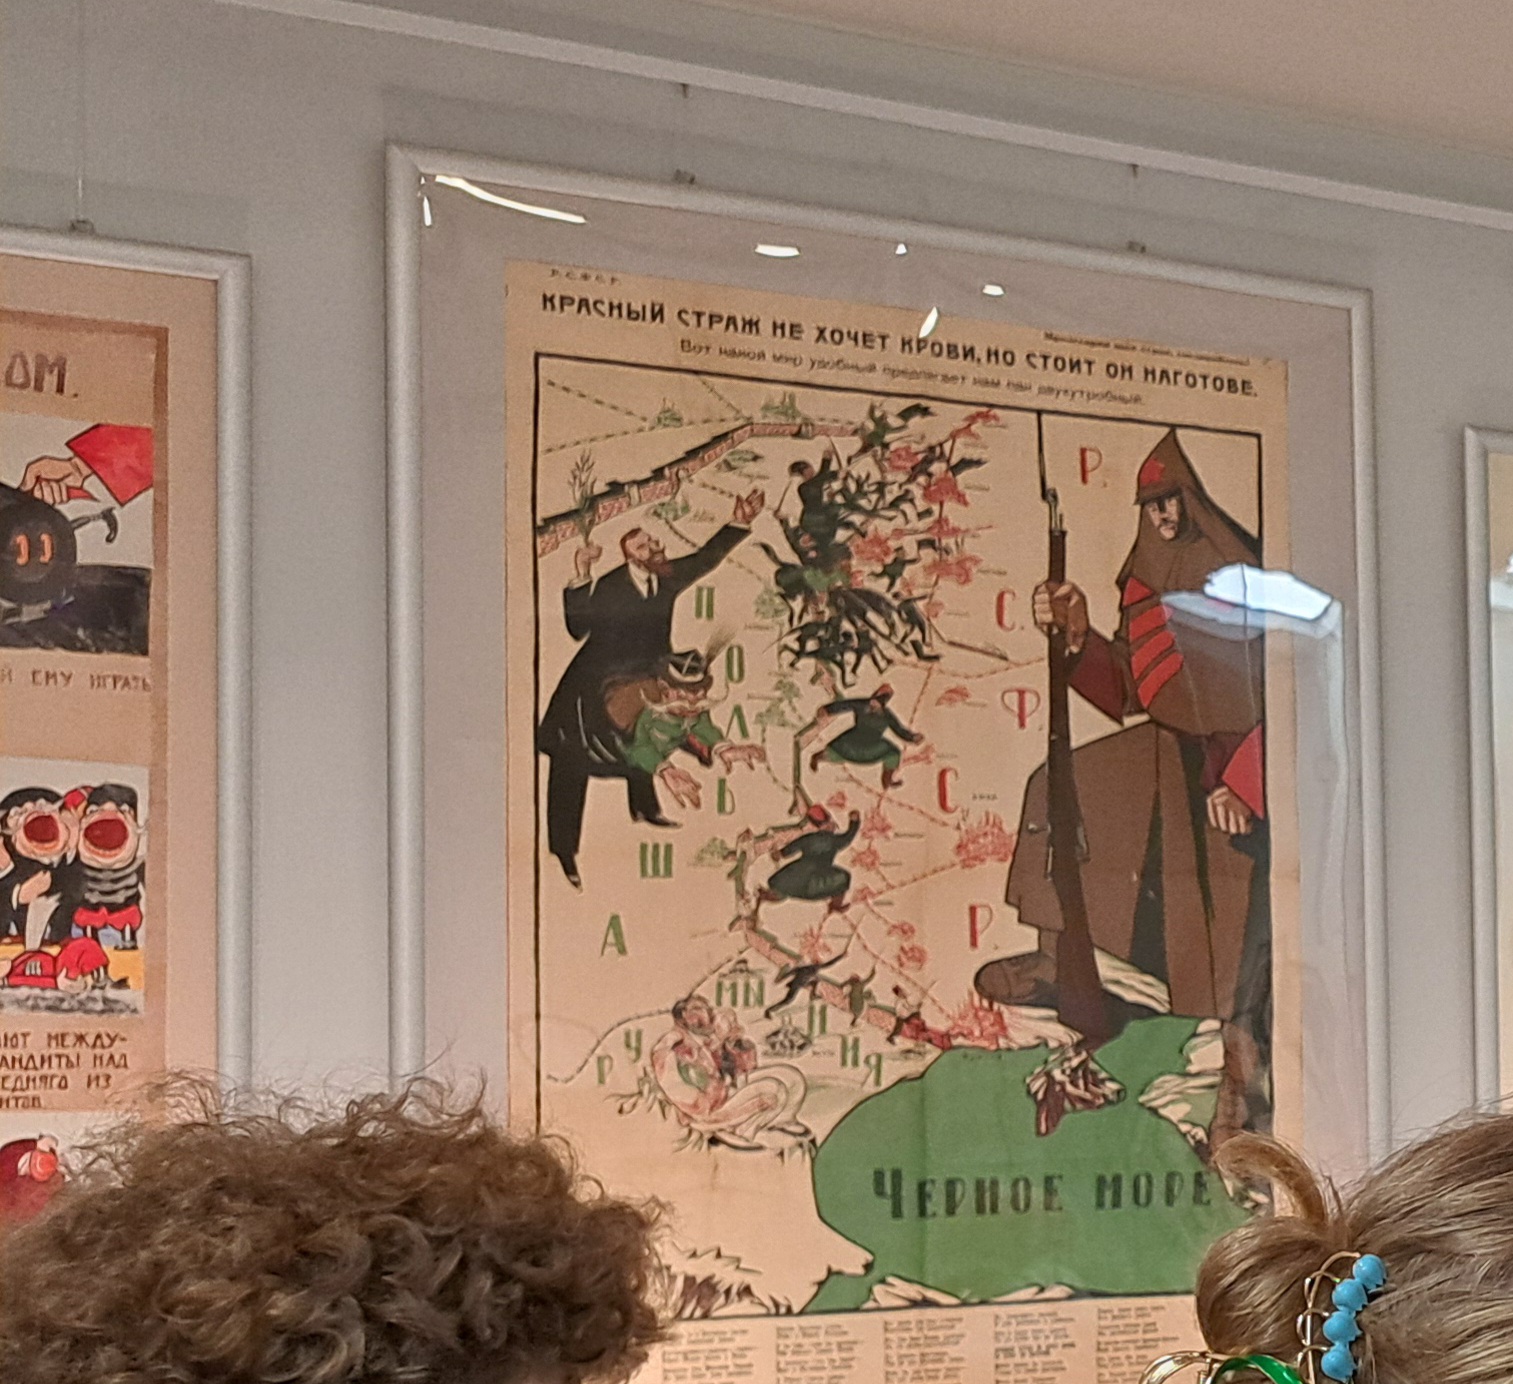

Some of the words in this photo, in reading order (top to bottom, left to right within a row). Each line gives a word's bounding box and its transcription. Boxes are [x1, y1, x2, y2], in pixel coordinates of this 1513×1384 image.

[541, 292, 665, 324] КРАСНЫЙ
[676, 309, 761, 336] СТРАЖ
[772, 321, 804, 341] НЕ
[814, 325, 891, 351] ХОЧЕТ
[986, 348, 1016, 367] НО
[1026, 352, 1096, 379] СТОИТ
[1105, 361, 1134, 382] ОН
[1143, 365, 1259, 398] НАГОТОВЕ.
[0, 1031, 31, 1049] ЮТ
[872, 1166, 1065, 1220] ЧЕРНОЕ
[1094, 1169, 1212, 1211] МОРЕ
